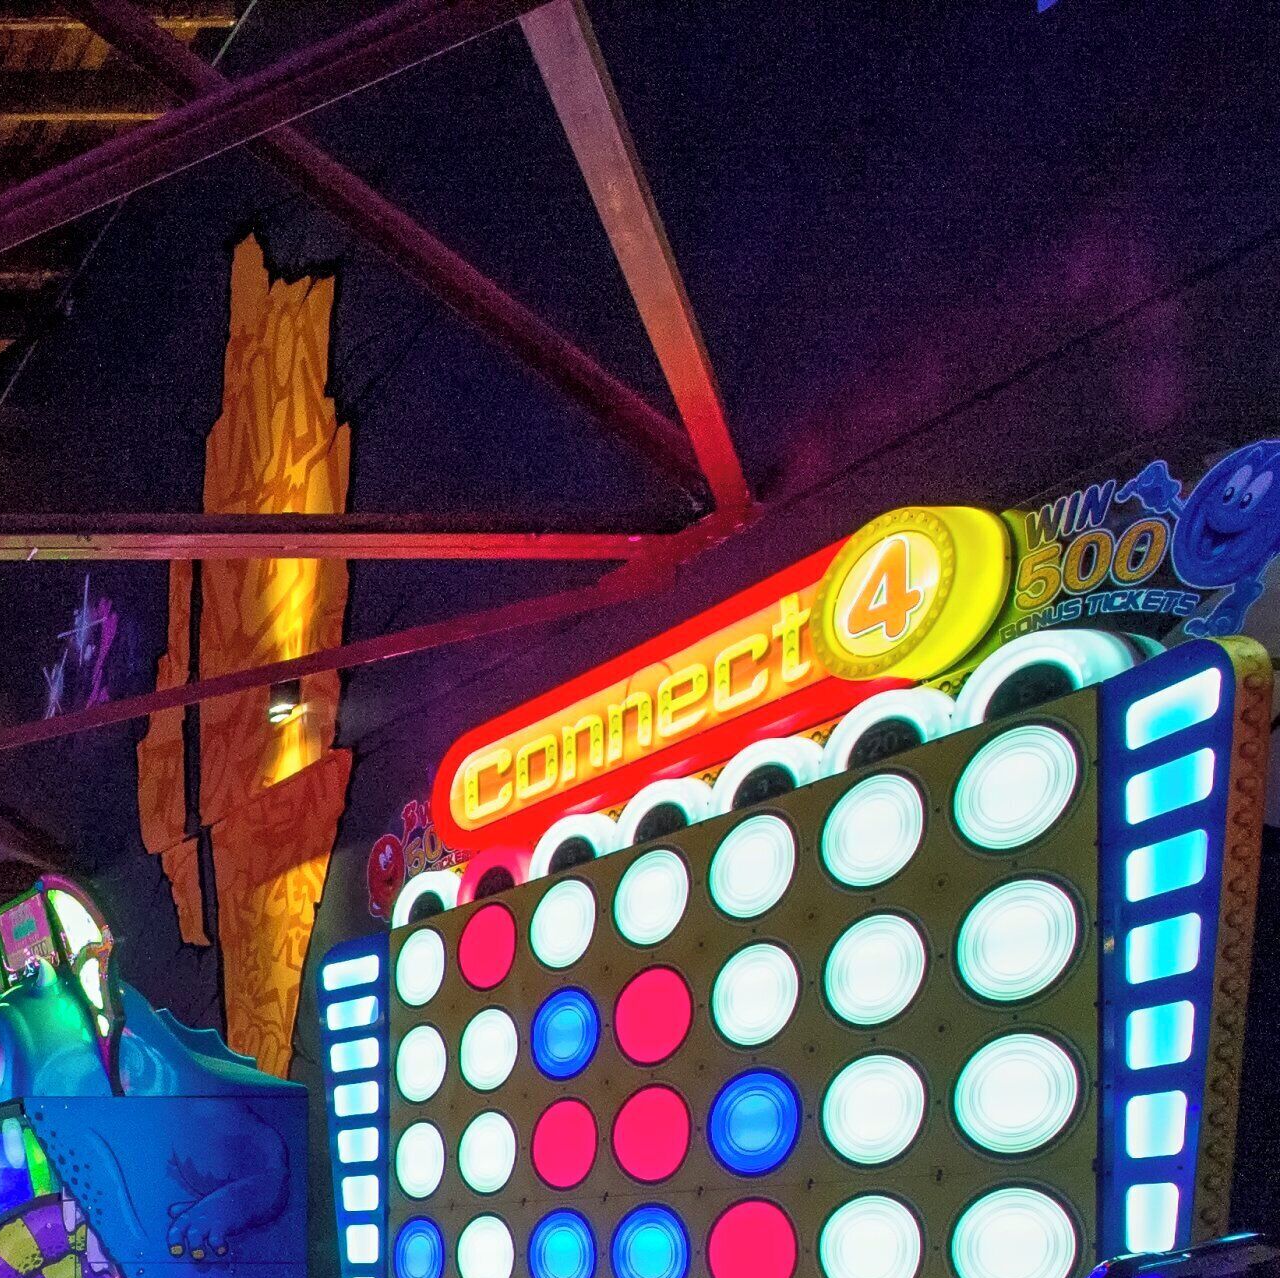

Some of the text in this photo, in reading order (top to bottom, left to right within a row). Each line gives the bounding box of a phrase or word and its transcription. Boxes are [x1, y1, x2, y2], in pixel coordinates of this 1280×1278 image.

[1024, 479, 1116, 551] WIN
[846, 535, 925, 643] 4
[1015, 518, 1170, 611] 500
[998, 589, 1200, 645] BONUS TICKETS
